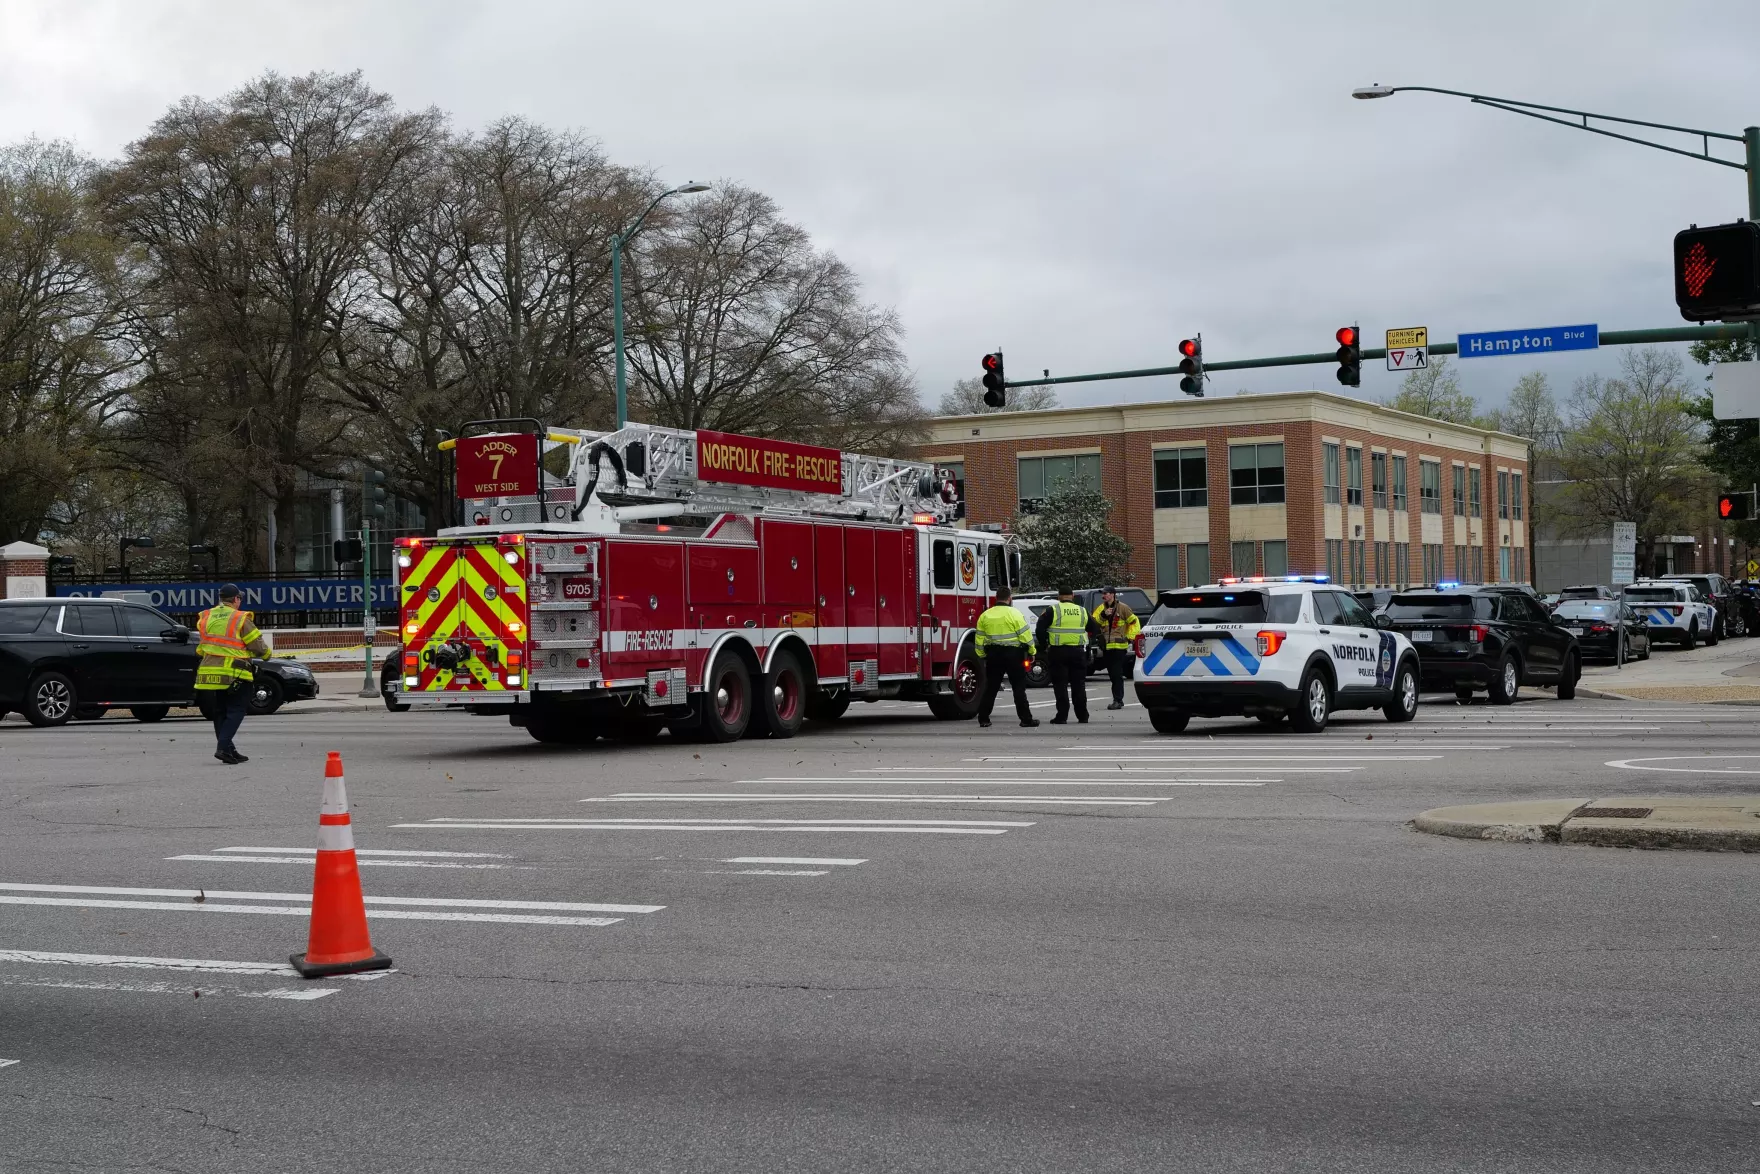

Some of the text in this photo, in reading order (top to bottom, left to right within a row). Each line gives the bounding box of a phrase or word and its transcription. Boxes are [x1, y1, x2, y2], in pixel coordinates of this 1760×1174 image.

[1388, 330, 1415, 338] TURNING
[1388, 337, 1415, 345] VEHICLES
[1470, 331, 1585, 353] Hampton Blvd
[474, 441, 518, 458] LADDER
[488, 454, 504, 480] 7
[702, 442, 839, 483] NORFOLK FIRE-RESCUE
[474, 482, 520, 493] WEST SIDE
[271, 584, 401, 605] UNIVERSIT
[565, 583, 591, 596] 9705
[1063, 608, 1080, 616] POLICE
[625, 629, 674, 651] FIRE-RESCUE
[941, 620, 951, 651] 7
[1332, 644, 1376, 662] NORFOLK
[1358, 668, 1375, 677] POLICE
